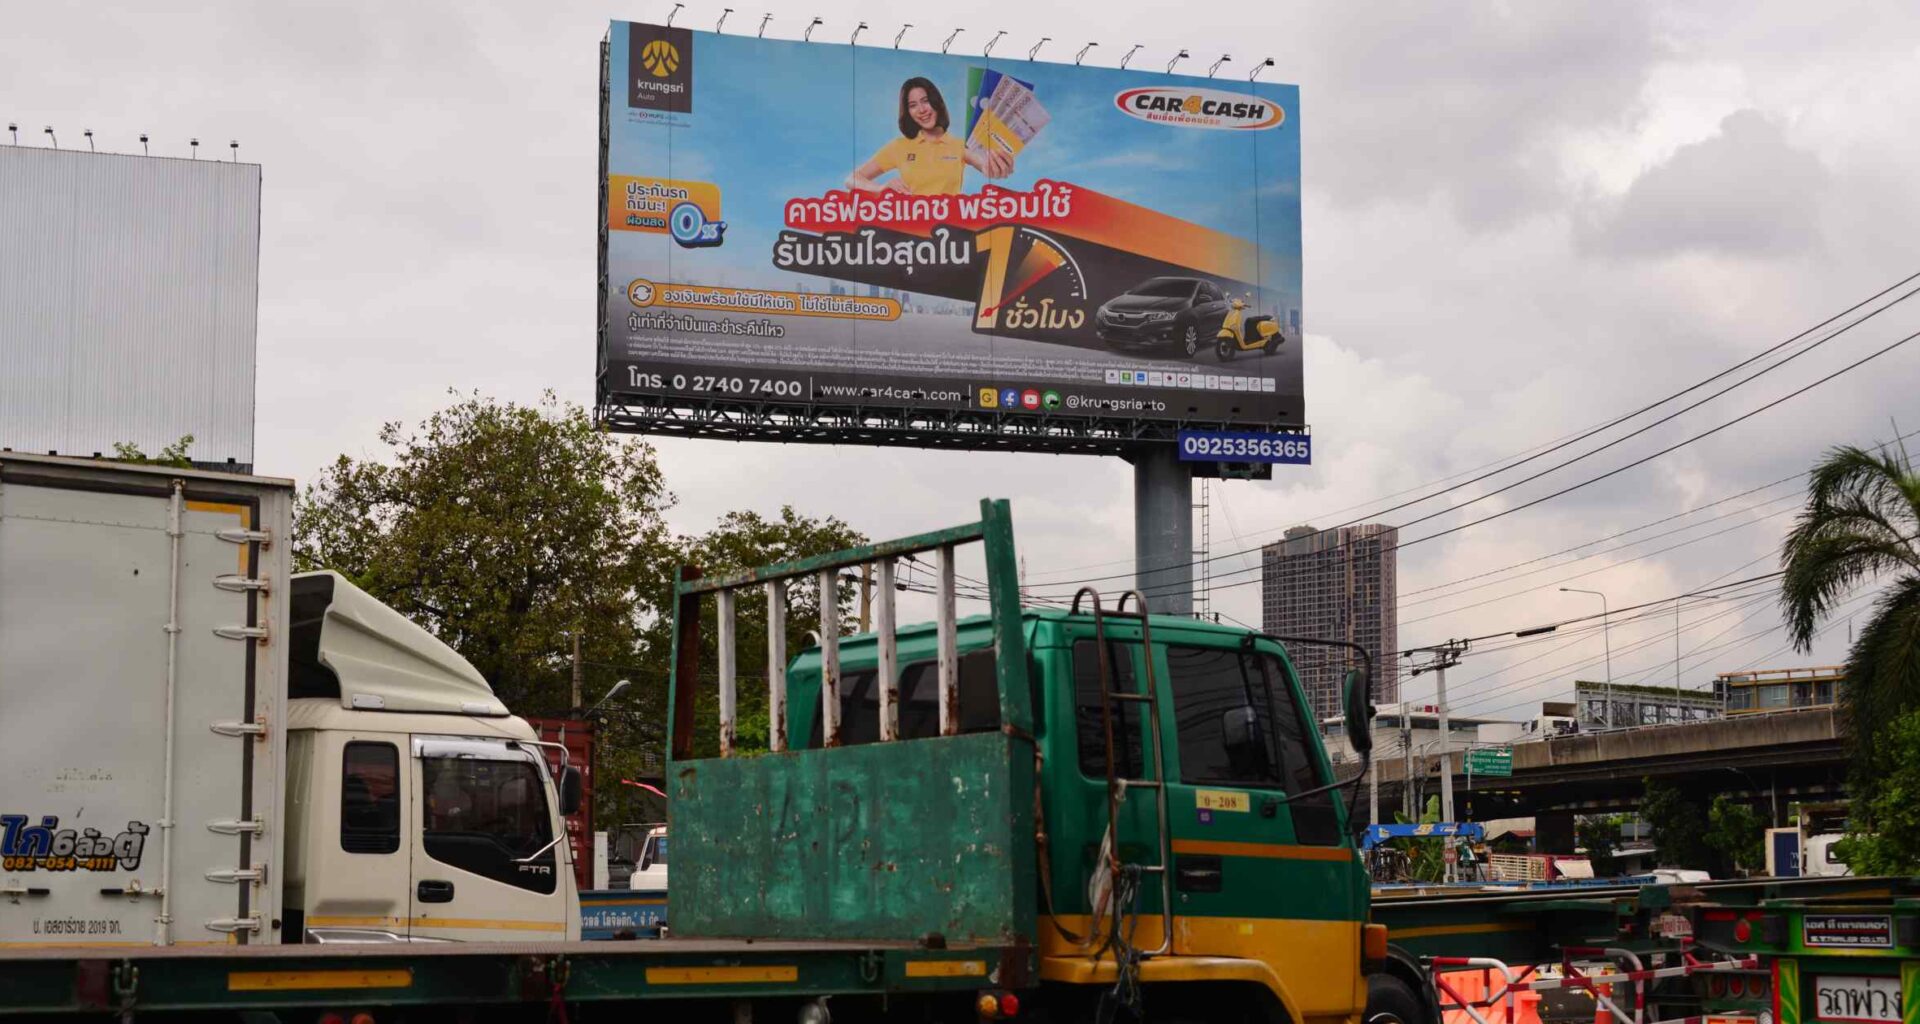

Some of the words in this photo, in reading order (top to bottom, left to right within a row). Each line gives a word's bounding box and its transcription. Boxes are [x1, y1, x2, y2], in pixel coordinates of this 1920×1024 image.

[637, 79, 684, 94] krungsri
[638, 93, 655, 101] Auto
[627, 182, 688, 199] ประกันรถ
[627, 195, 666, 212] ก็มีนะ!
[788, 193, 949, 223] คาร์ฟอร์แคช
[958, 183, 1071, 220] พร้อมใช้
[776, 228, 970, 275] รับเงินไวสุดใน
[663, 290, 794, 311] วงเงินพร้อมใช้มีให้เบิก
[800, 294, 889, 316] ไม่ใช้ไม่เสียดอก
[1005, 296, 1085, 329] ชั่วโมง
[627, 311, 785, 338] กู้เท่าที่จำเป็นและชำระคืนไหว
[627, 365, 667, 388] โทร.
[673, 374, 686, 390] 0
[693, 376, 743, 393] 2740
[749, 379, 802, 396] 7400
[1066, 395, 1165, 411] @krugsriato
[1184, 437, 1308, 459] 0925356365
[0, 815, 149, 871] ไก่6ล้อตู้
[518, 865, 551, 875] FTR
[88, 920, 106, 934] 2019
